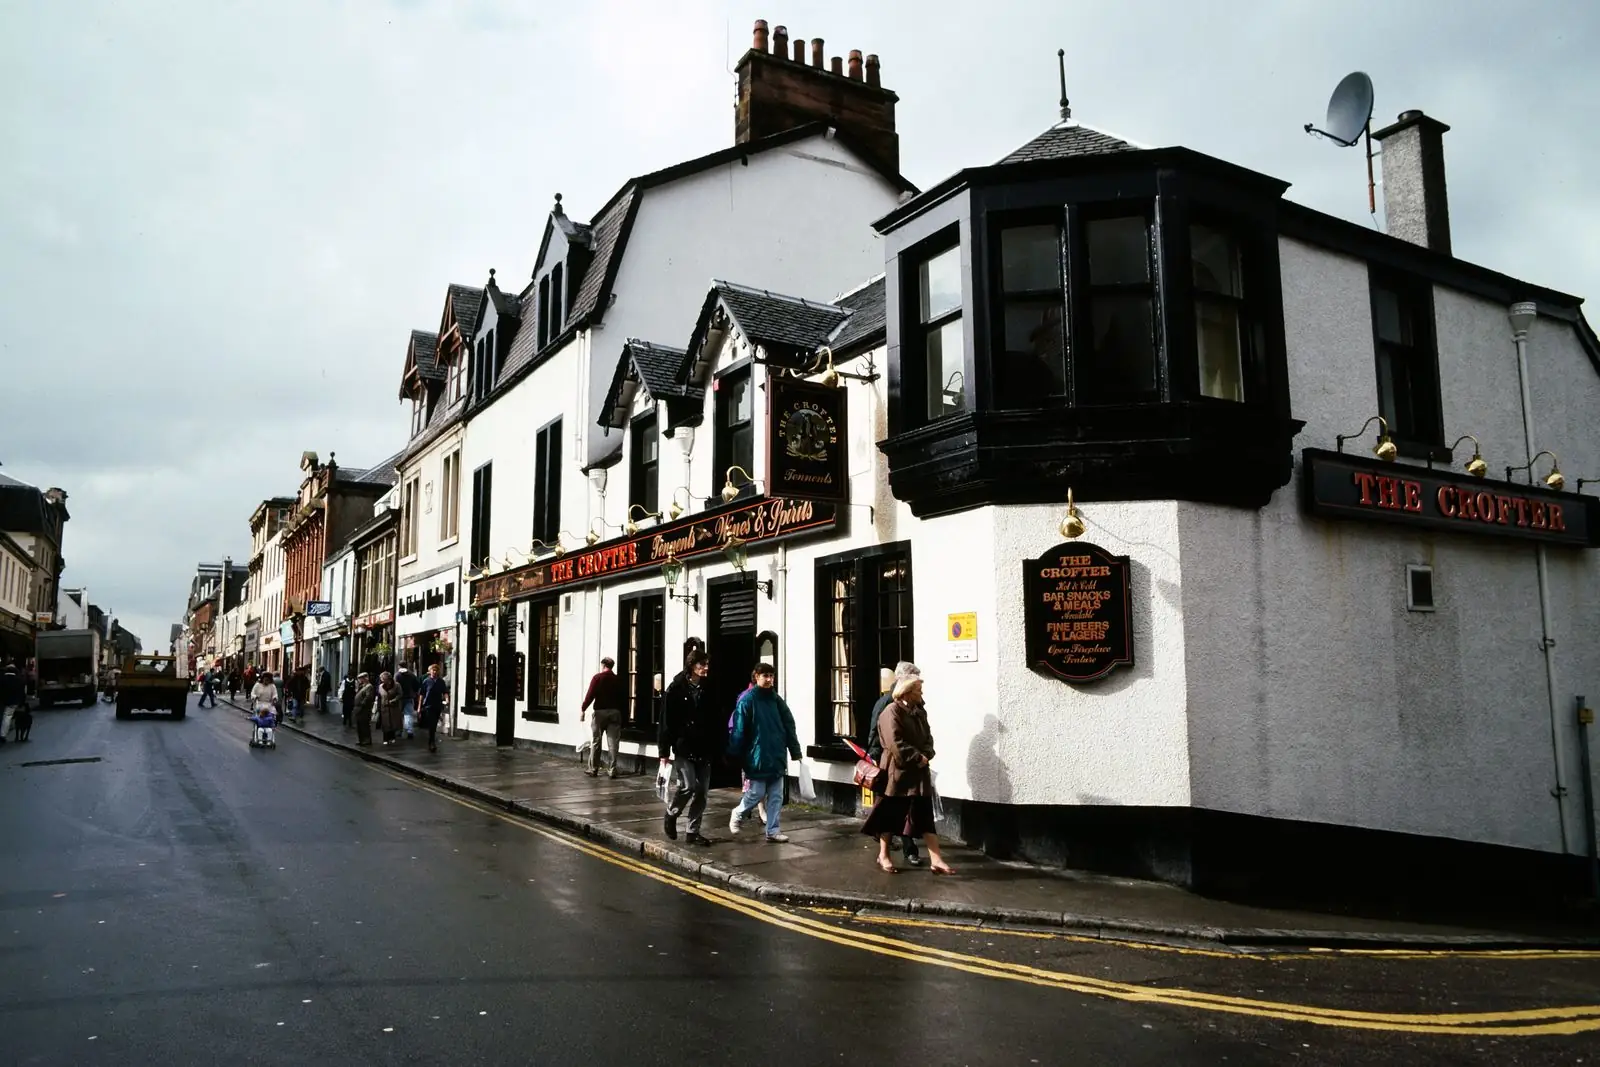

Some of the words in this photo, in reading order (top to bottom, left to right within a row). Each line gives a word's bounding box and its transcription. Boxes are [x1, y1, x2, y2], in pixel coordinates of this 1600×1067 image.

[779, 410, 791, 438] THE
[793, 401, 837, 444] CROFTER
[1354, 472, 1423, 512] THE
[1438, 484, 1566, 531] CROFTER
[755, 505, 767, 539] &
[768, 499, 813, 537] Spirits
[551, 560, 573, 583] THE
[577, 542, 636, 576] CROFTER
[1059, 555, 1091, 566] THE
[1040, 566, 1112, 578] CROFTER
[1043, 592, 1065, 602] BAR
[1066, 590, 1111, 601] SNACKS
[1053, 601, 1062, 611] &
[1063, 600, 1102, 610] MEALS
[1047, 622, 1071, 633] FINE
[1073, 620, 1110, 631] BEERS
[1052, 632, 1060, 641] &
[1062, 630, 1106, 641] LAGERS
[1048, 644, 1070, 656] Open
